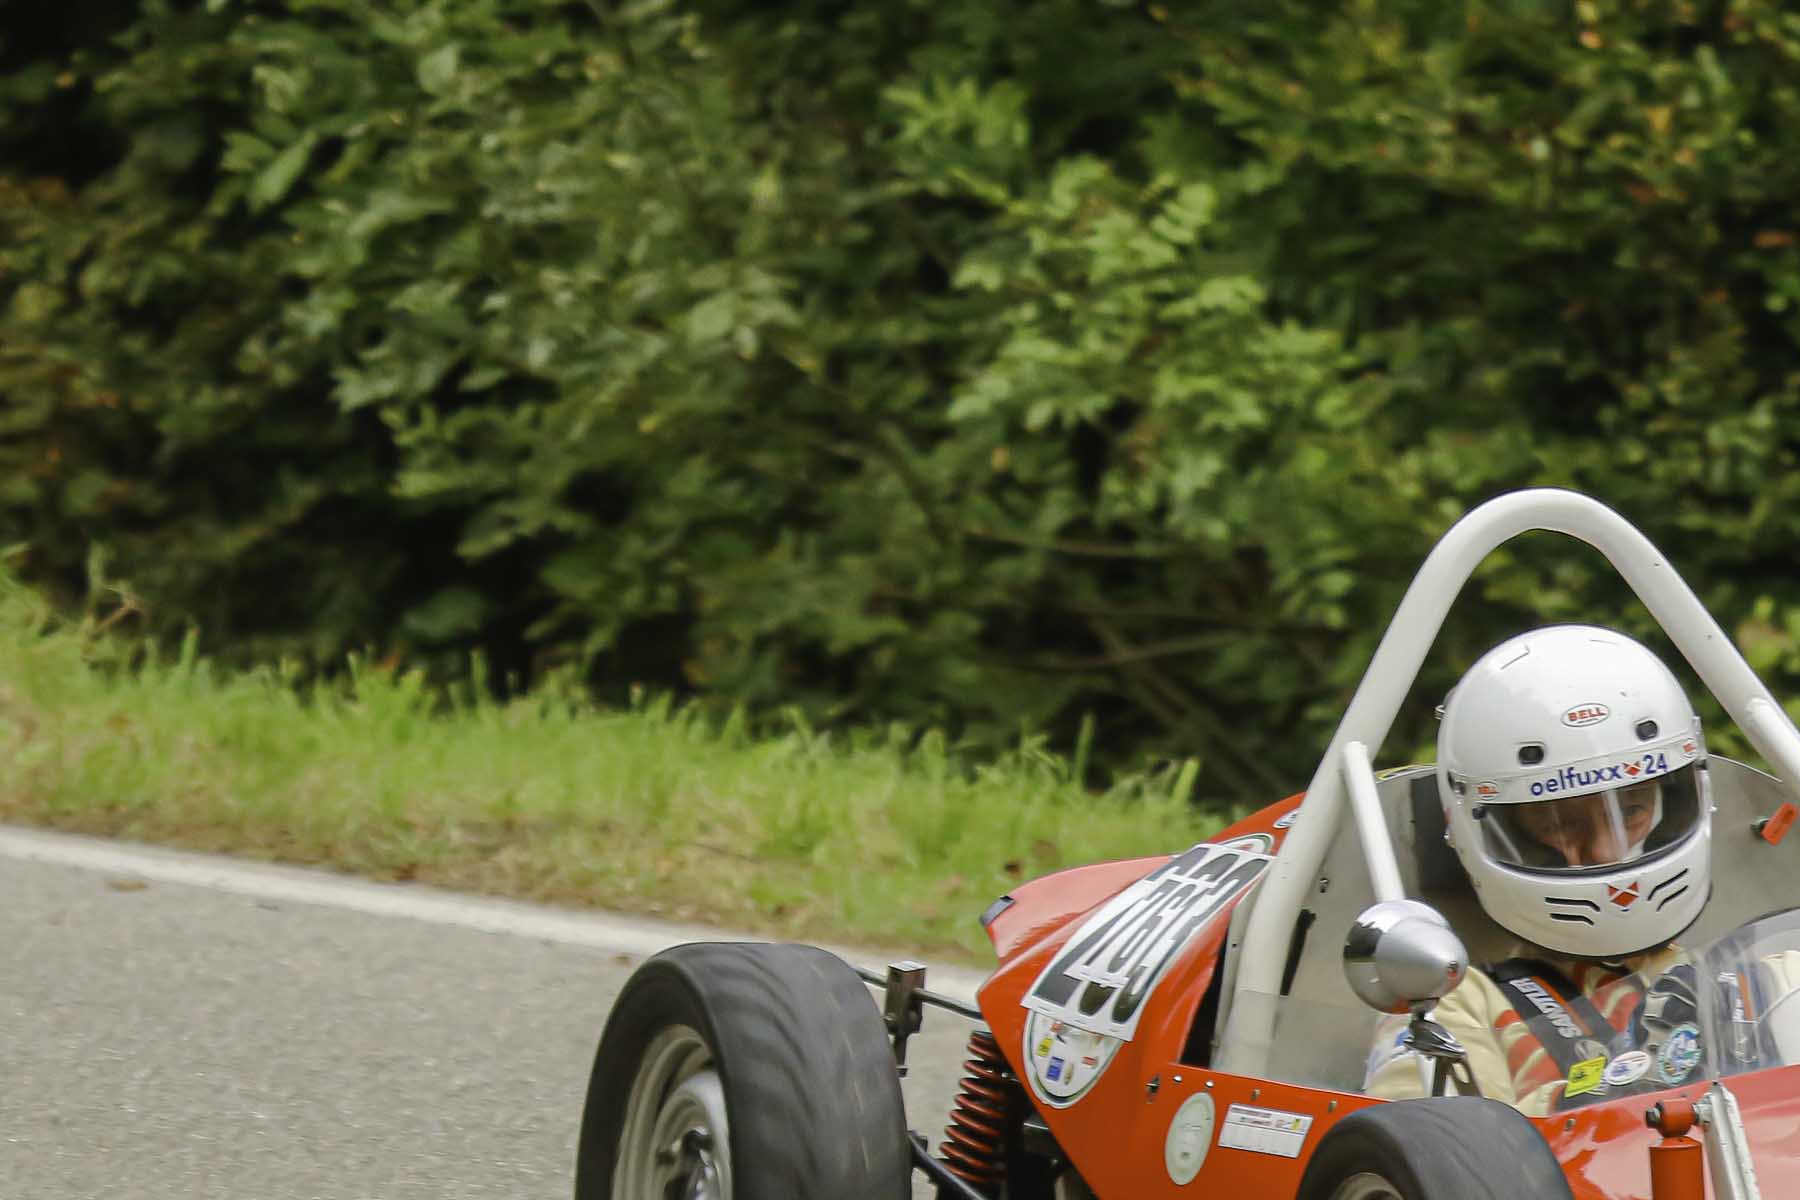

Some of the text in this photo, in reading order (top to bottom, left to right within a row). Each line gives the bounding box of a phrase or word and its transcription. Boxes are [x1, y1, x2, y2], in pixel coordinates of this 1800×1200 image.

[1568, 707, 1607, 722] BELL
[1530, 766, 1622, 797] oelfuxx
[1643, 752, 1668, 775] 24
